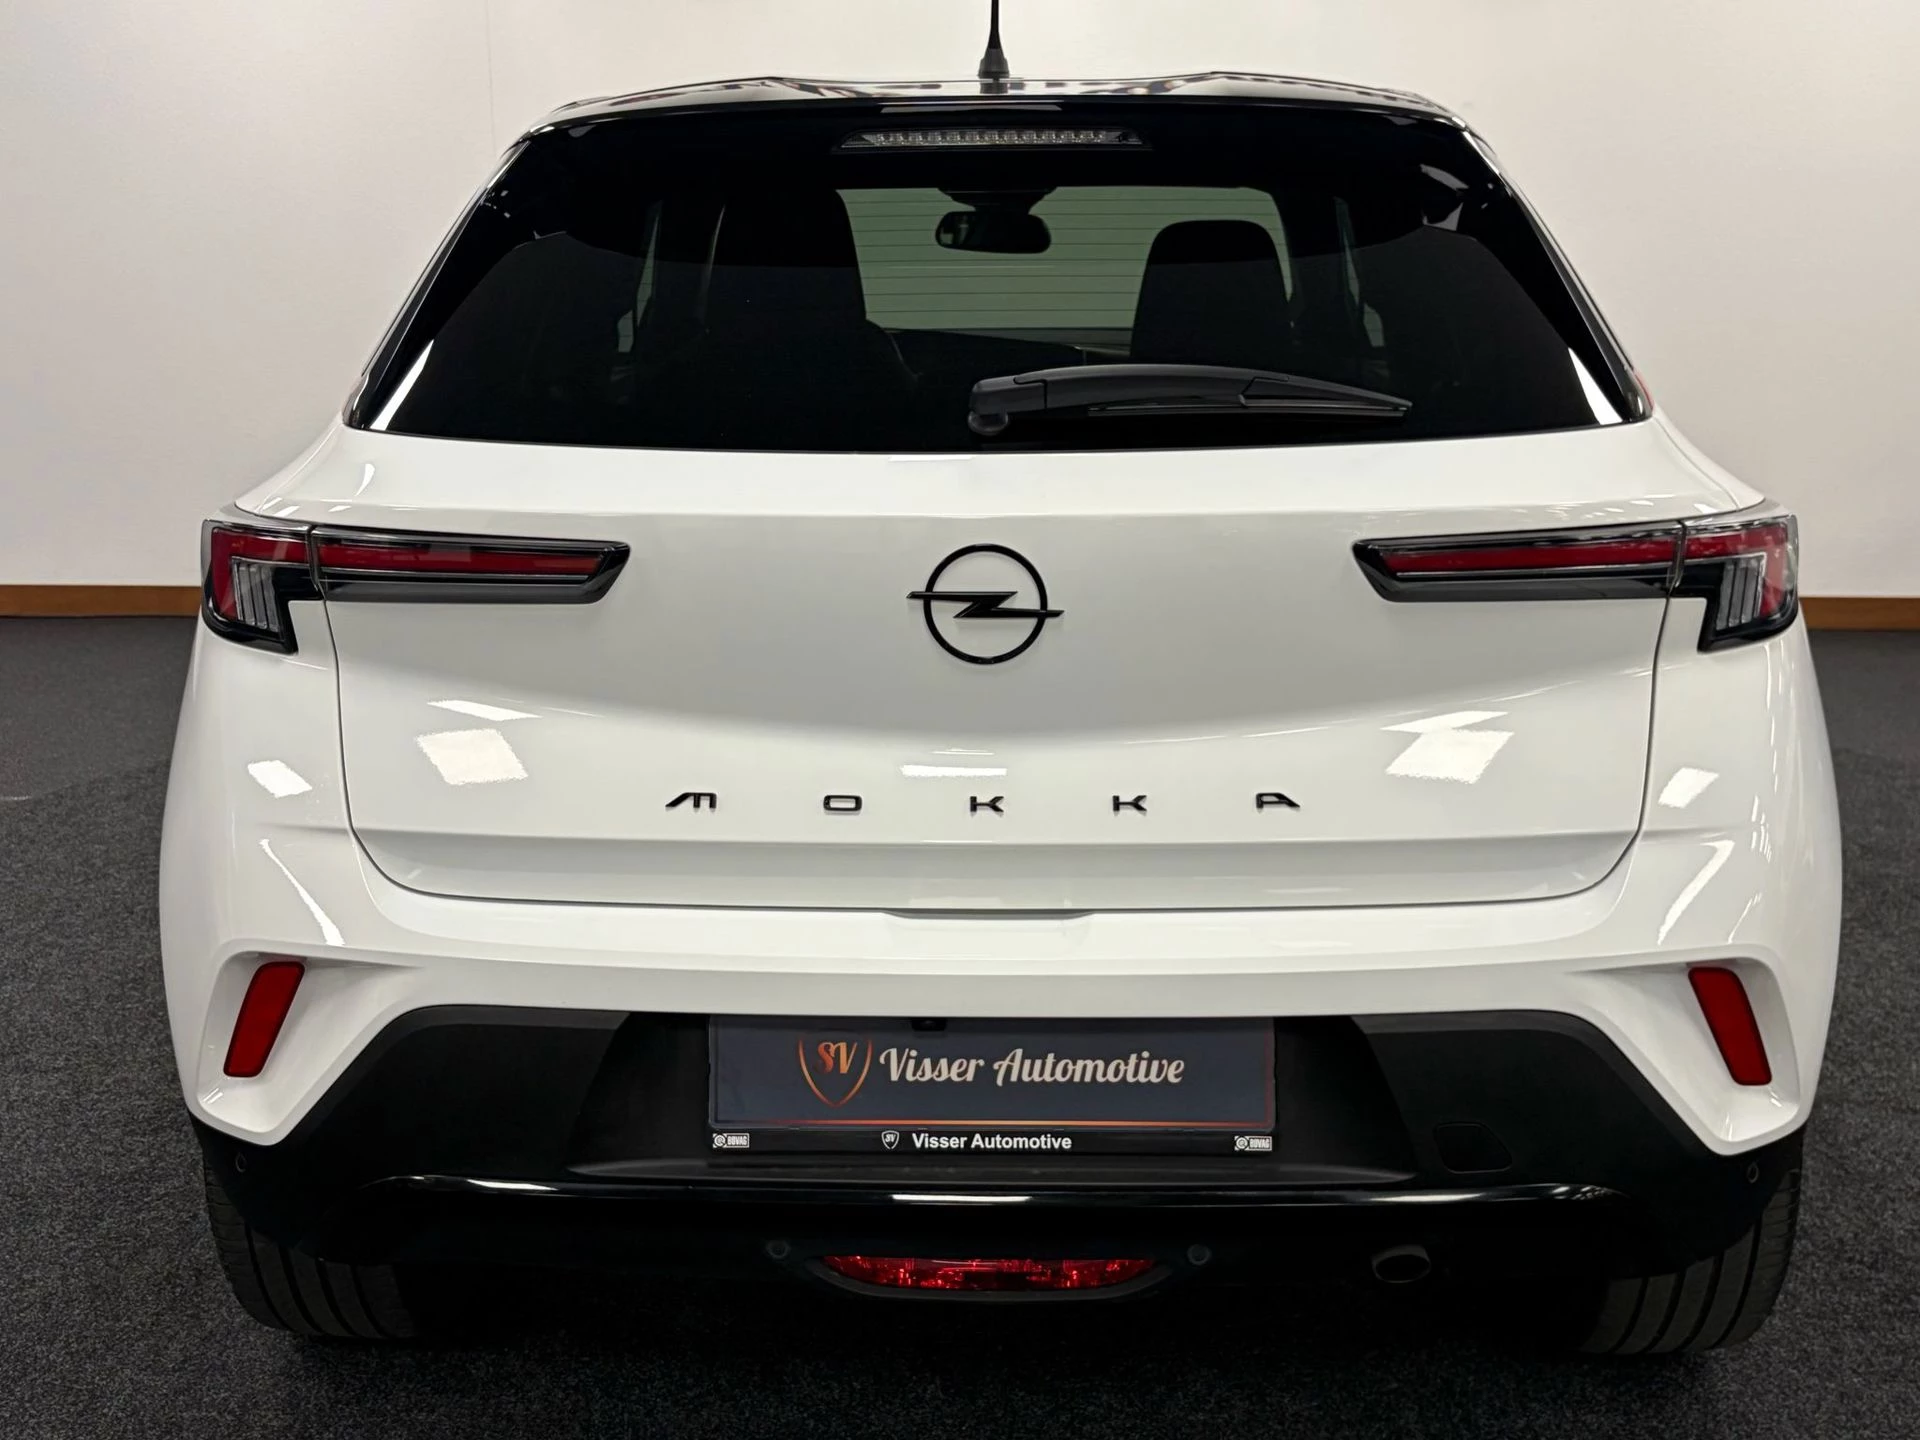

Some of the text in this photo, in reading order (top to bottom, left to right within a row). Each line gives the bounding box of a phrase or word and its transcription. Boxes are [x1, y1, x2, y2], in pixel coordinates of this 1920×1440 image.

[665, 791, 1301, 813] MOKKA
[879, 1047, 1185, 1087] Visser Automotive
[912, 1132, 1072, 1150] Visser Automotive
